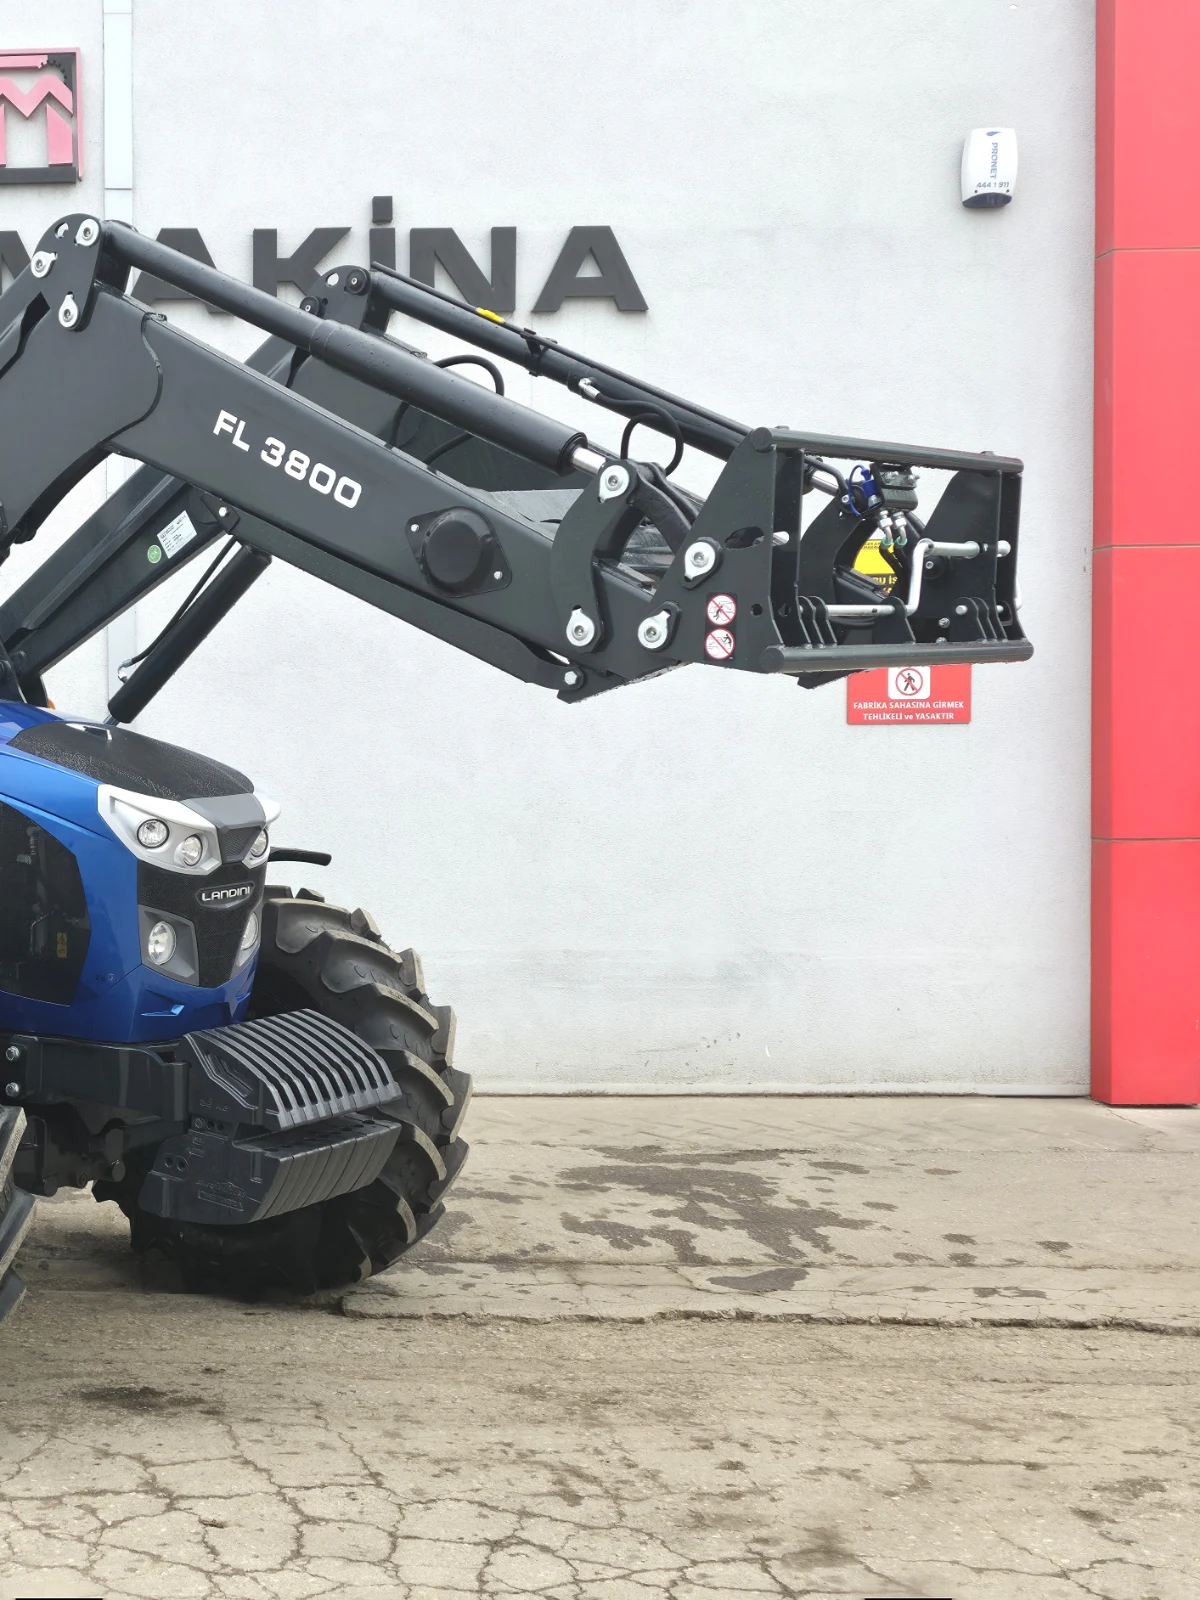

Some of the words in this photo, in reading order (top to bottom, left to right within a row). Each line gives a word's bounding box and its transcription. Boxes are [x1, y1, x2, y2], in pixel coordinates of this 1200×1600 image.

[990, 142, 999, 179] PRONET
[212, 409, 250, 452] FL
[260, 436, 363, 509] 3800
[853, 700, 888, 709] FABRİKA
[889, 701, 931, 709] SAHASINA
[933, 700, 964, 709] GİRMEK
[863, 712, 903, 720] TEHLİKELİ
[915, 712, 954, 720] YASAKTIR
[201, 886, 250, 902] LANDINI
